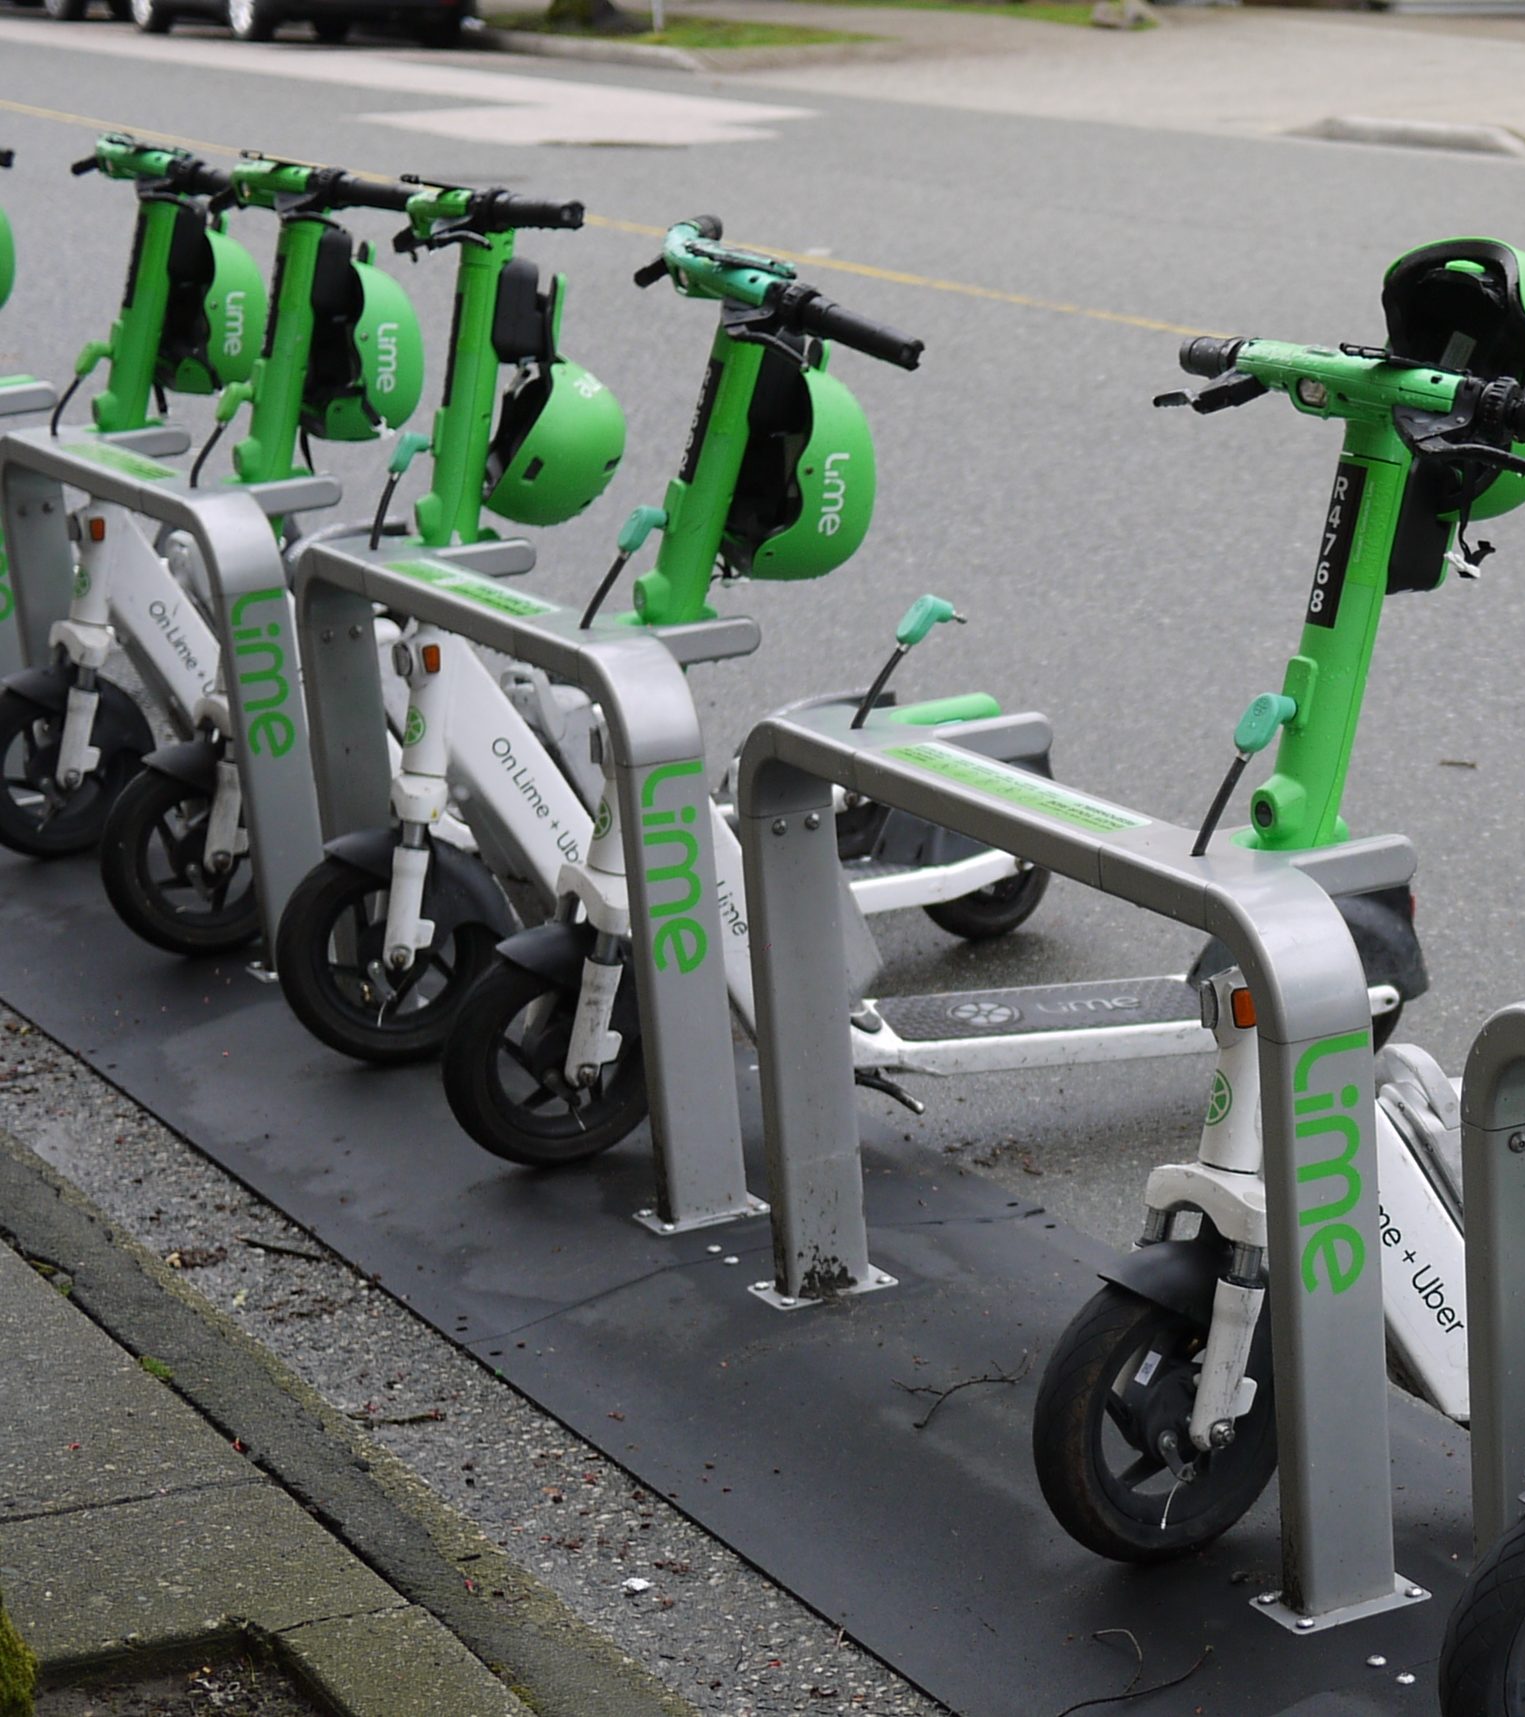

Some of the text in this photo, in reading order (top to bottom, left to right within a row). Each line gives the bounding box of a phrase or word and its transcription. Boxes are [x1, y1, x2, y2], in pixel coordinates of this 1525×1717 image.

[224, 291, 246, 357] Lime
[376, 322, 398, 394] Lime
[818, 452, 850, 536] Lime
[1310, 476, 1349, 613] R4768
[231, 587, 296, 758] Lime
[492, 737, 517, 771] On
[512, 767, 550, 818] Lime
[641, 760, 709, 974] Lime
[1293, 1029, 1369, 1296] Lime
[1402, 1250, 1416, 1263] +
[1412, 1264, 1464, 1333] Uber
